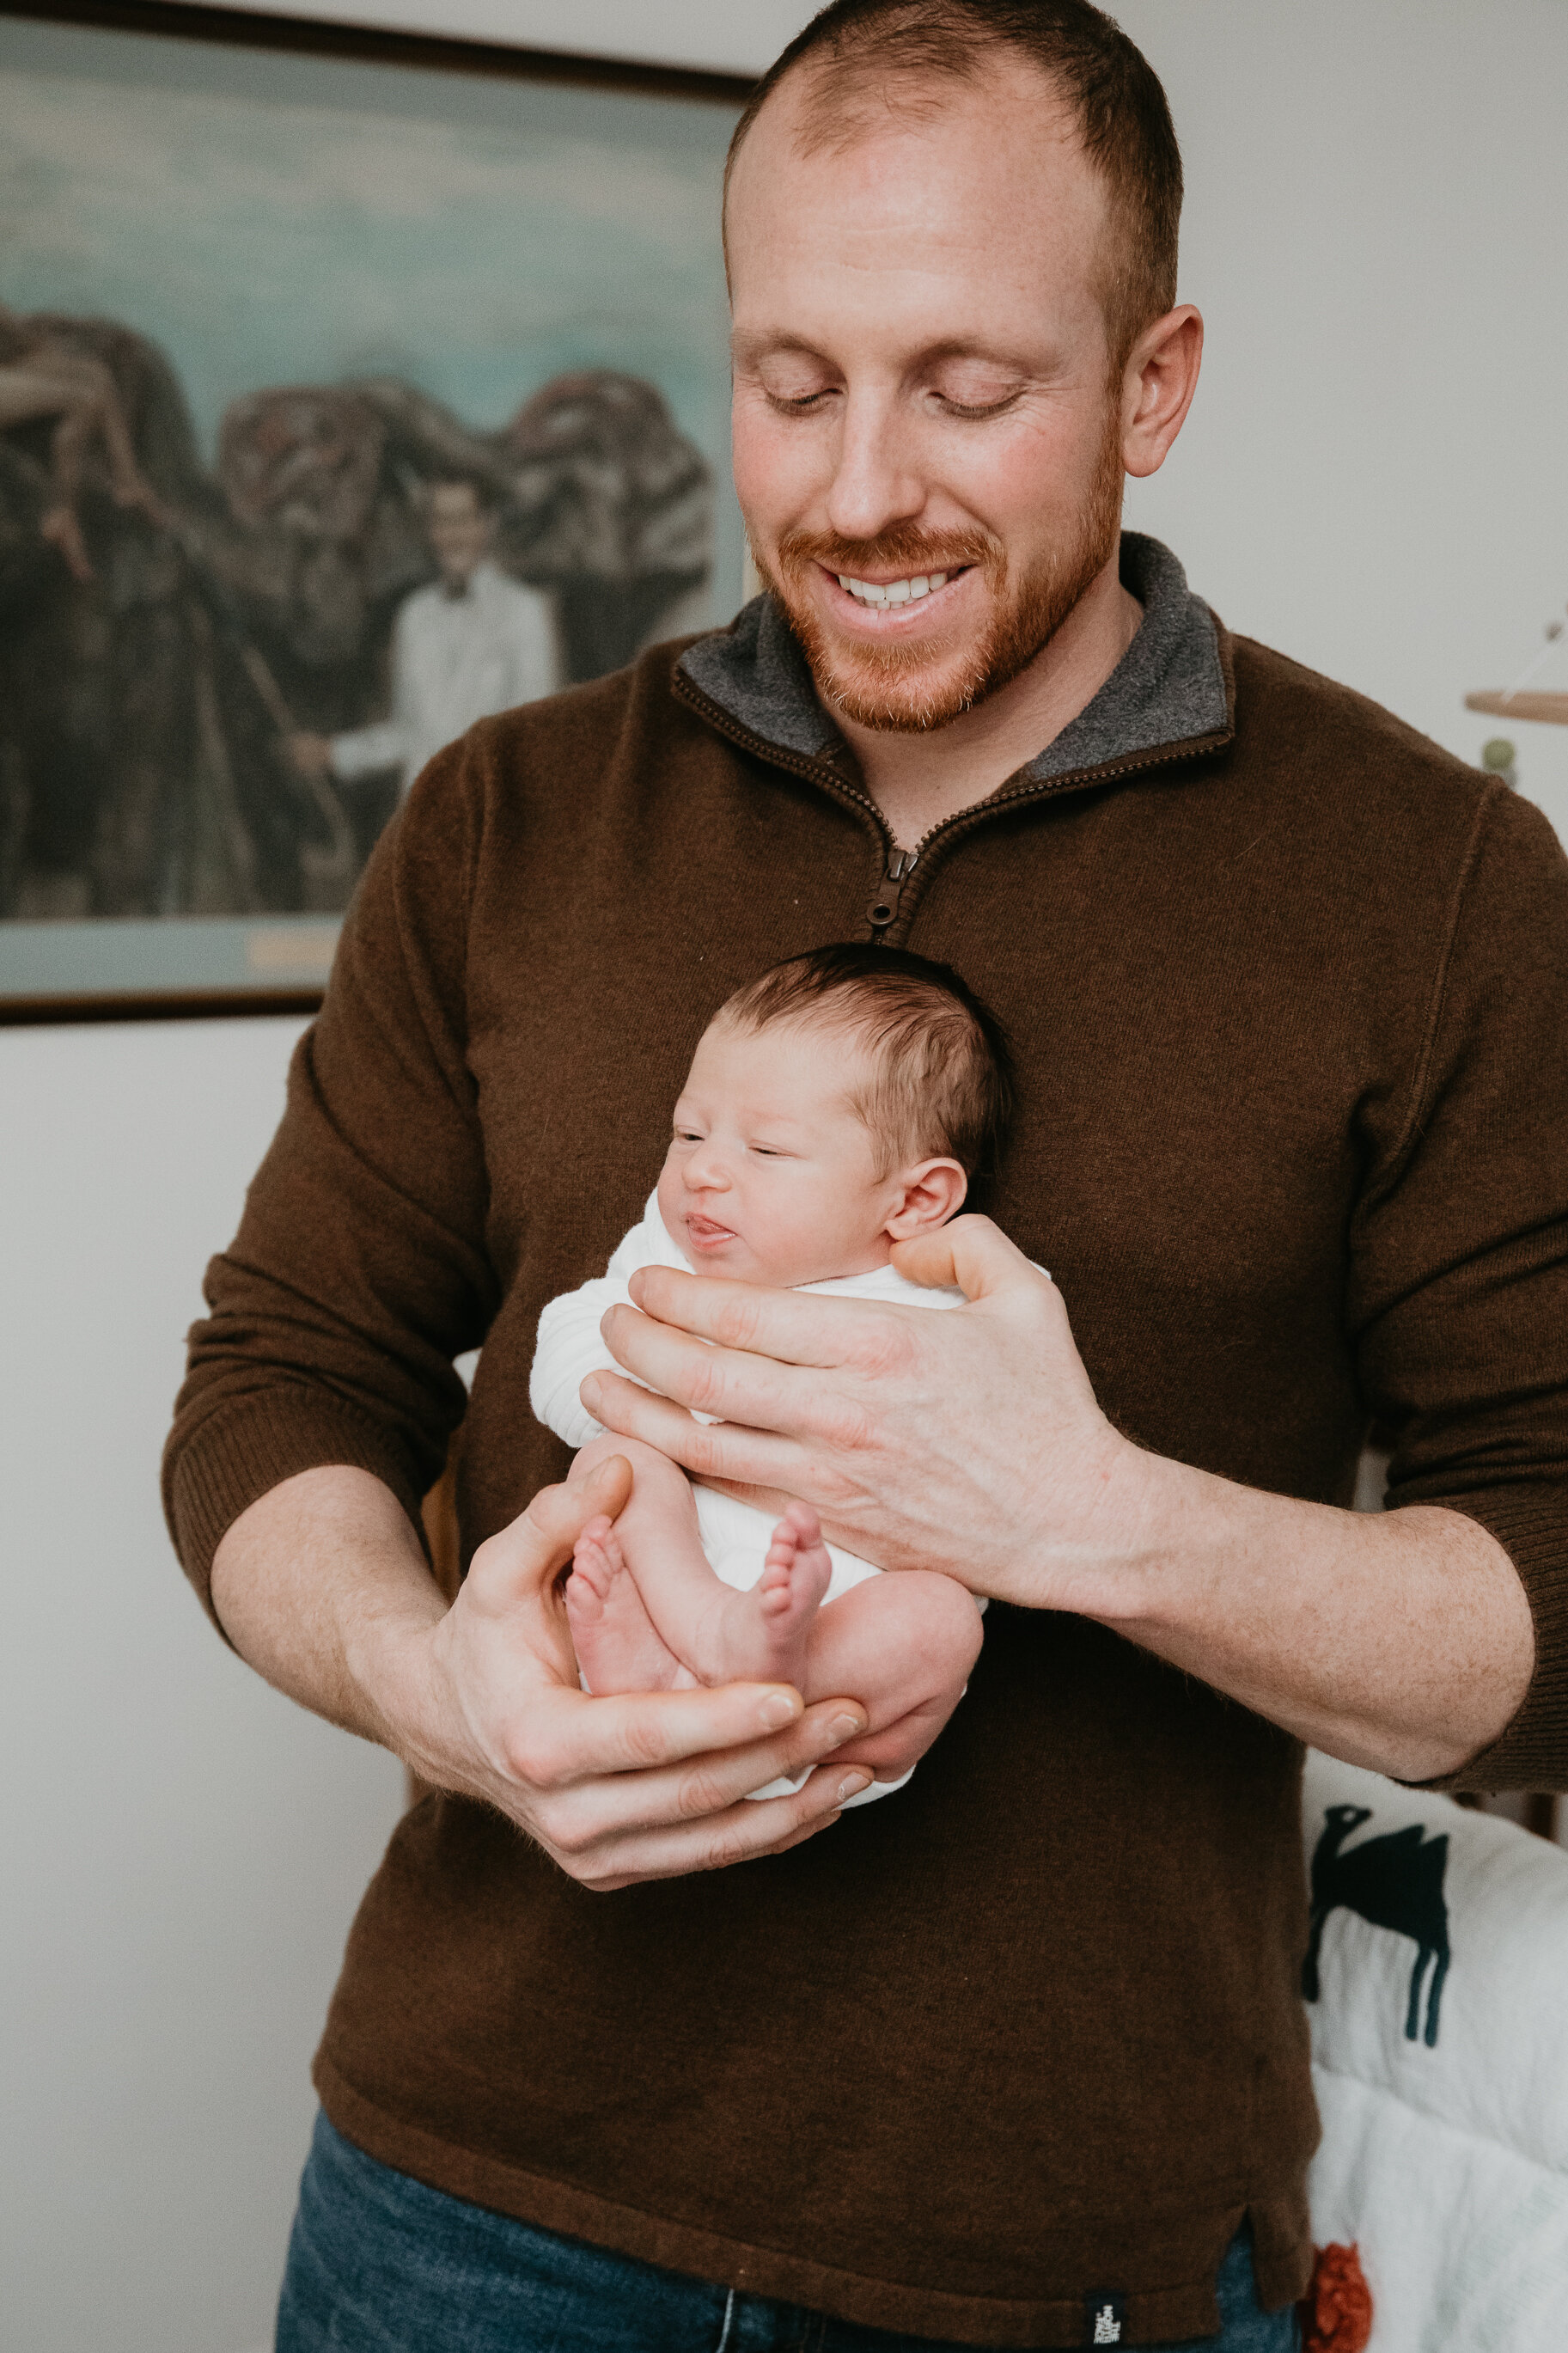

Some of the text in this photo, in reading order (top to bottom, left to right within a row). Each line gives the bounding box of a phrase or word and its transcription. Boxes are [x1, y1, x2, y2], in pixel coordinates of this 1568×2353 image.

[1094, 2318, 1104, 2344] FACE
[1103, 2305, 1113, 2343] NORTH
[1112, 2321, 1120, 2342] THE
